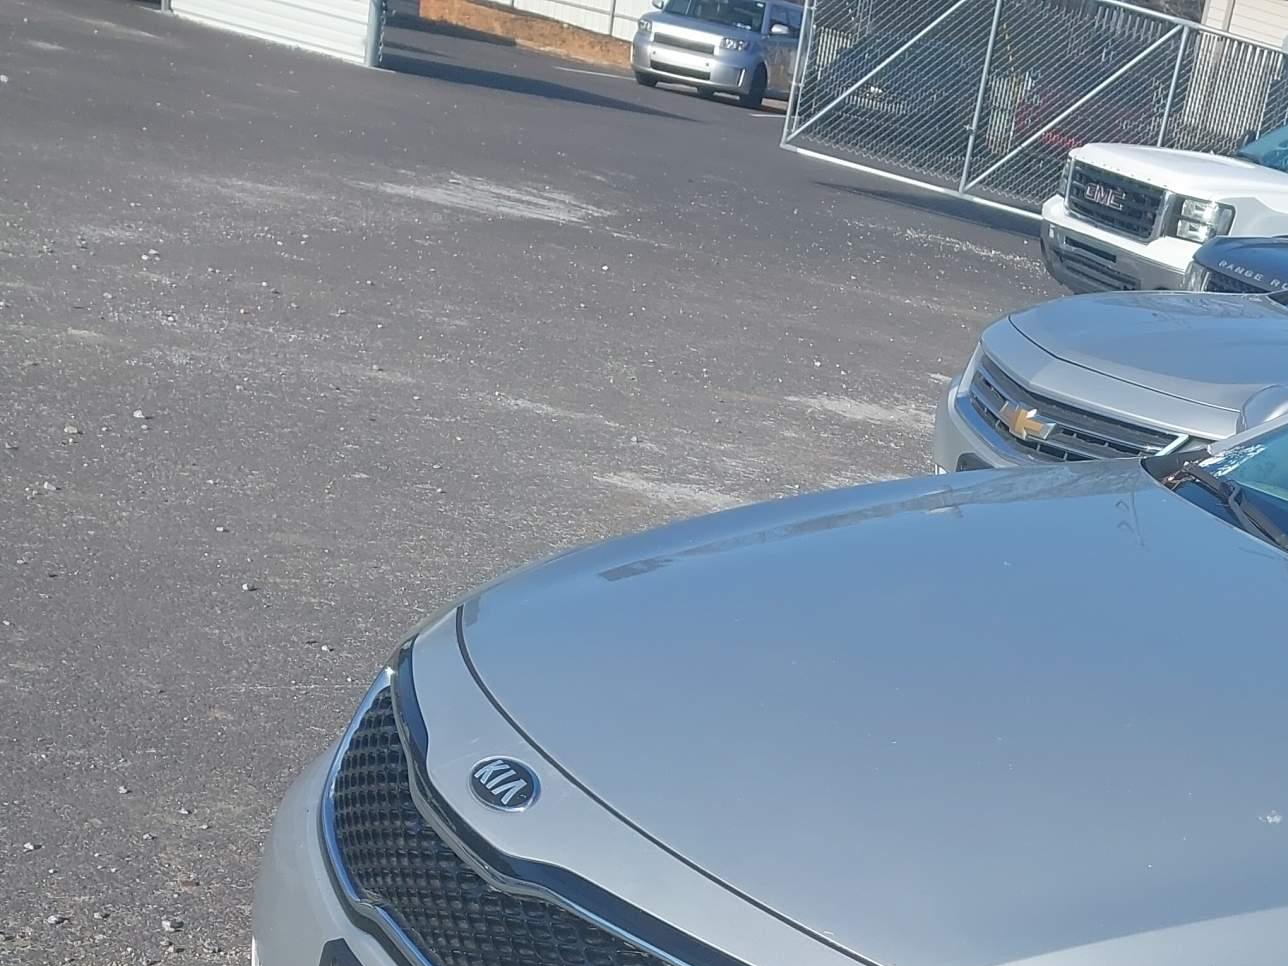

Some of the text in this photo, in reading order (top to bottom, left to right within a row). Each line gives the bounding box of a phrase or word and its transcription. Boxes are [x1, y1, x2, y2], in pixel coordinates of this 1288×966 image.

[1084, 182, 1126, 212] GMC
[1218, 260, 1264, 282] RANGE
[473, 759, 528, 805] KIA
